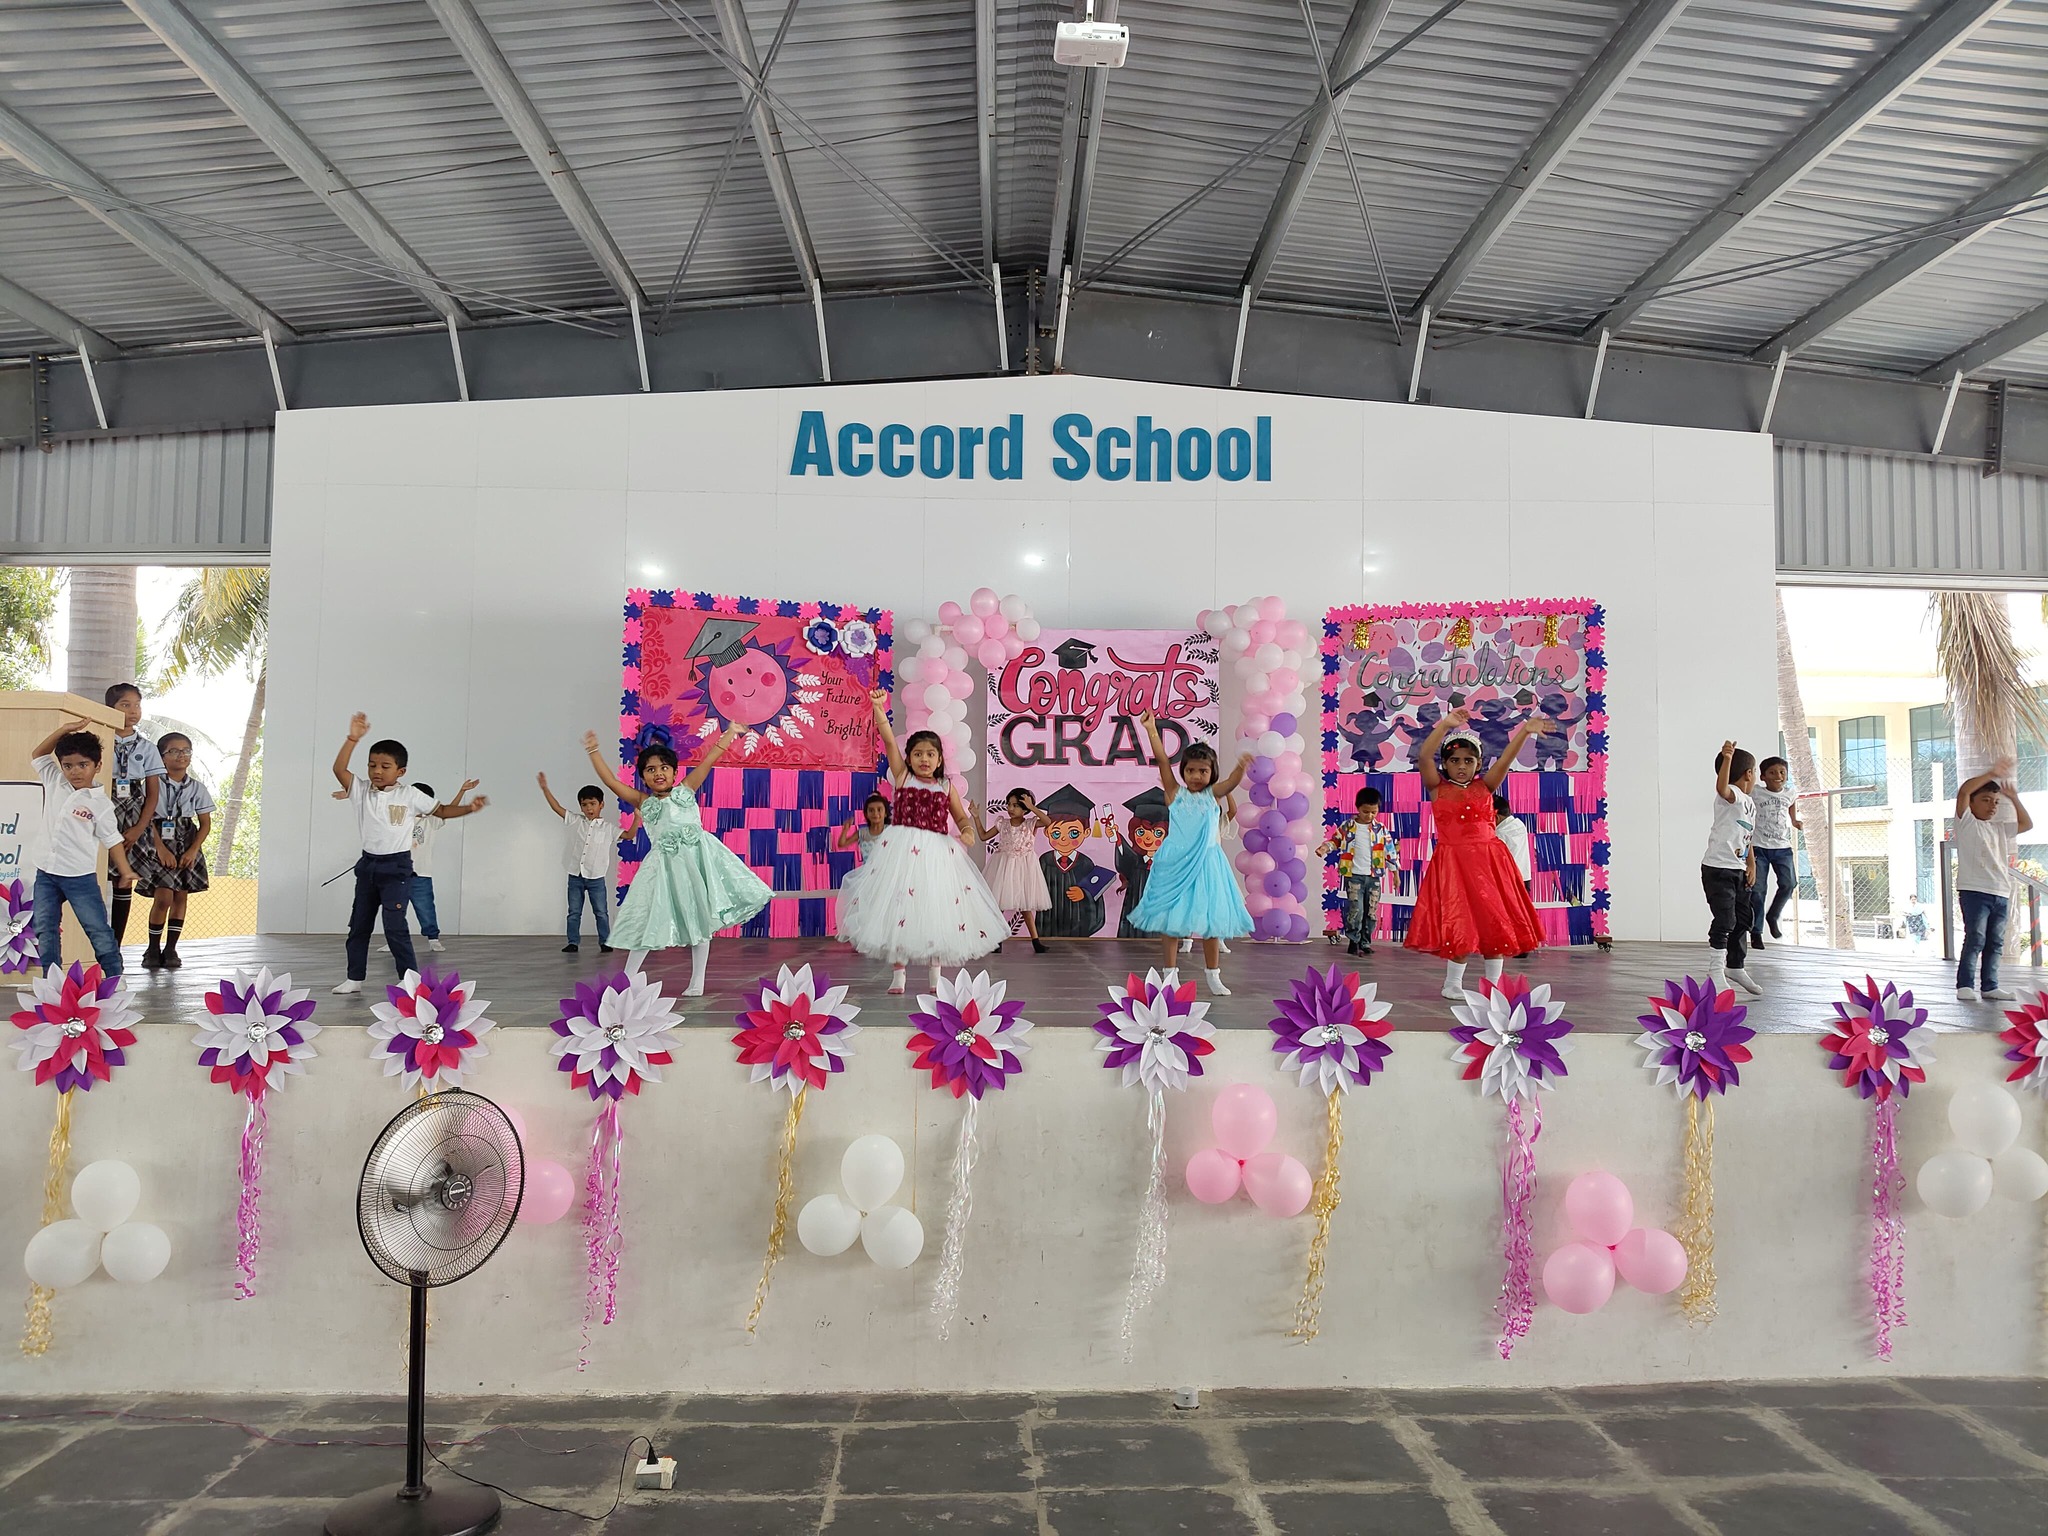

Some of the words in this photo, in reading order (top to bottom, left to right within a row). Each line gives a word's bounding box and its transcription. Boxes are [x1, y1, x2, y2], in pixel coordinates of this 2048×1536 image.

[789, 410, 1024, 480] Accord
[1052, 413, 1272, 482] School
[820, 670, 844, 686] Your
[997, 643, 1210, 733] Congrats
[1356, 641, 1580, 711] Congratulations
[820, 706, 829, 718] is
[826, 688, 862, 705] Future
[1000, 713, 1191, 768] GRAD
[388, 804, 408, 826] W
